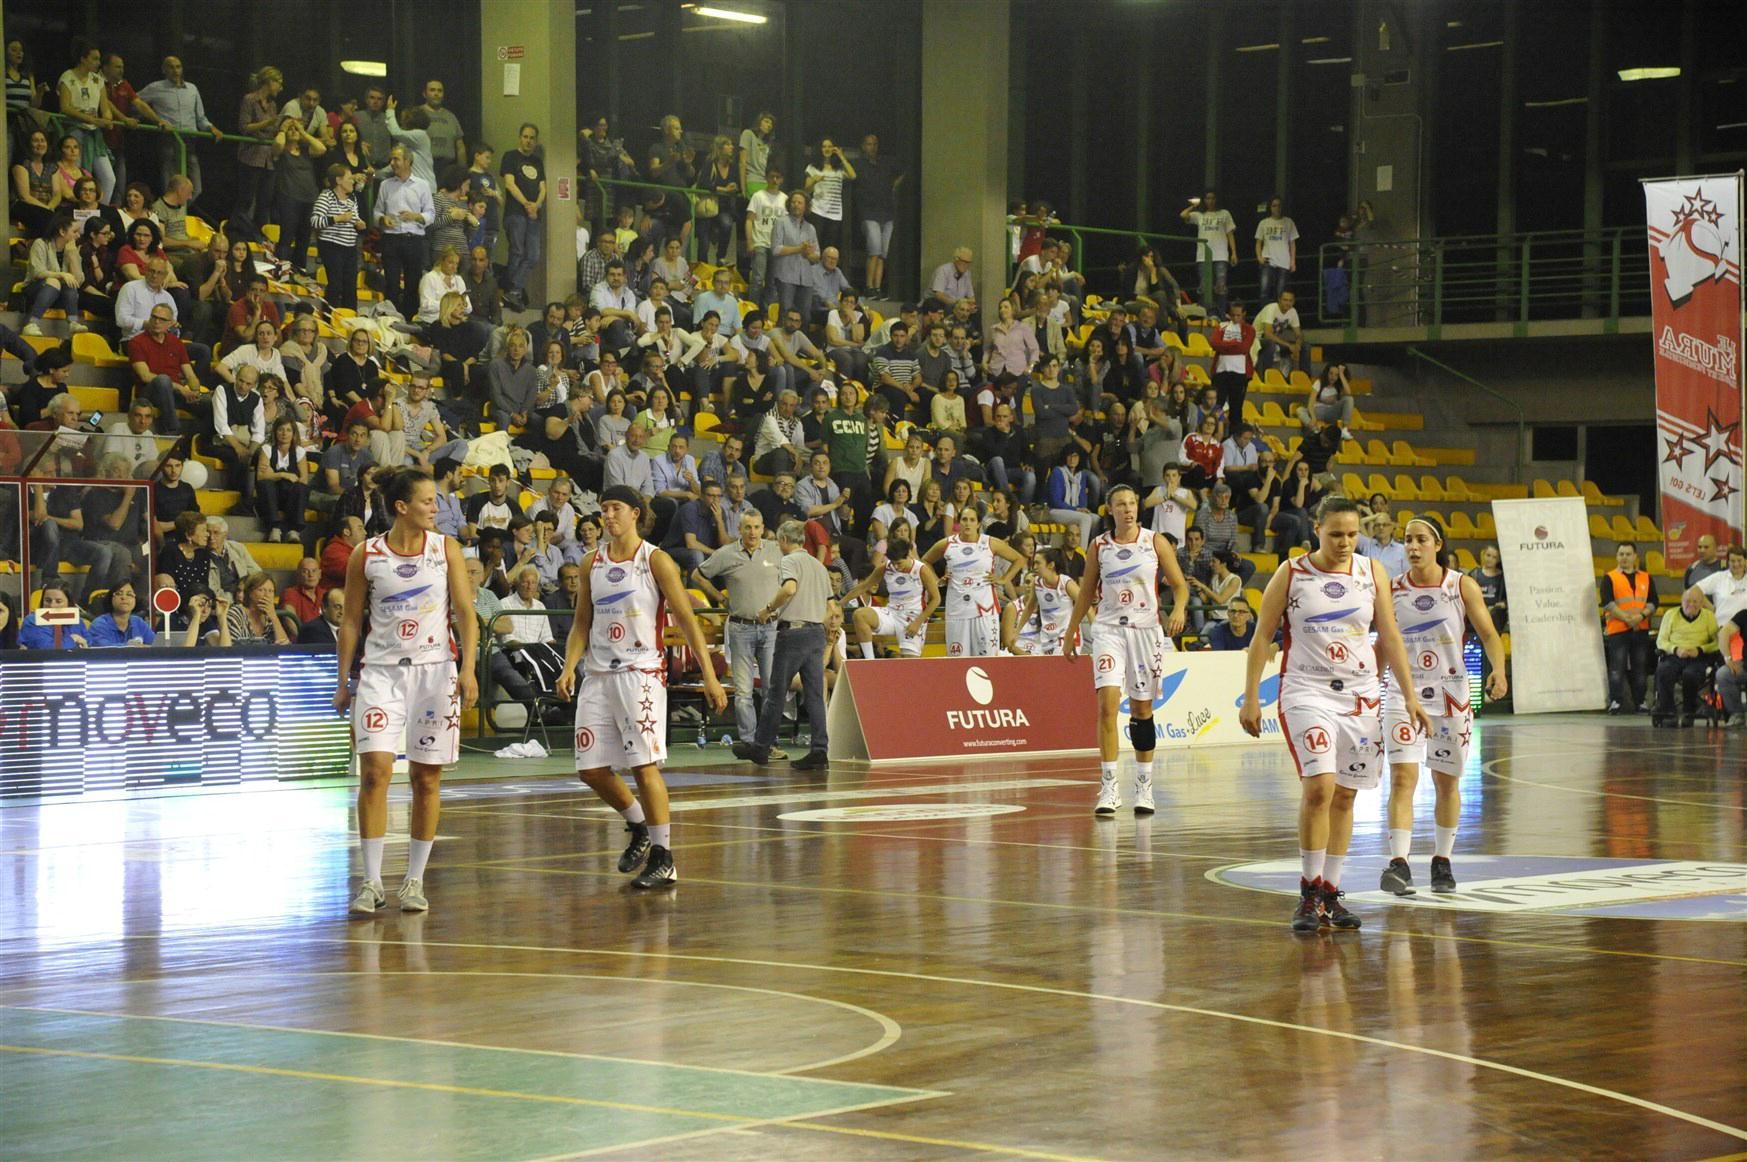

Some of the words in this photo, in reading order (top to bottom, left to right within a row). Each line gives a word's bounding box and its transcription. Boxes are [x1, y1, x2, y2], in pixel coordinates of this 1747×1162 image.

[1520, 541, 1565, 551] FUTURA
[1121, 593, 1132, 603] 21
[401, 623, 416, 637] 12
[609, 626, 621, 639] 10
[1329, 646, 1345, 660] 14
[1099, 658, 1112, 670] 21
[1423, 655, 1432, 667] 8
[366, 713, 384, 729] 12
[946, 708, 1030, 730] FUTURA
[1167, 723, 1187, 738] Gas
[1400, 727, 1411, 741] 8
[576, 731, 590, 749] 10
[1306, 731, 1328, 750] 14
